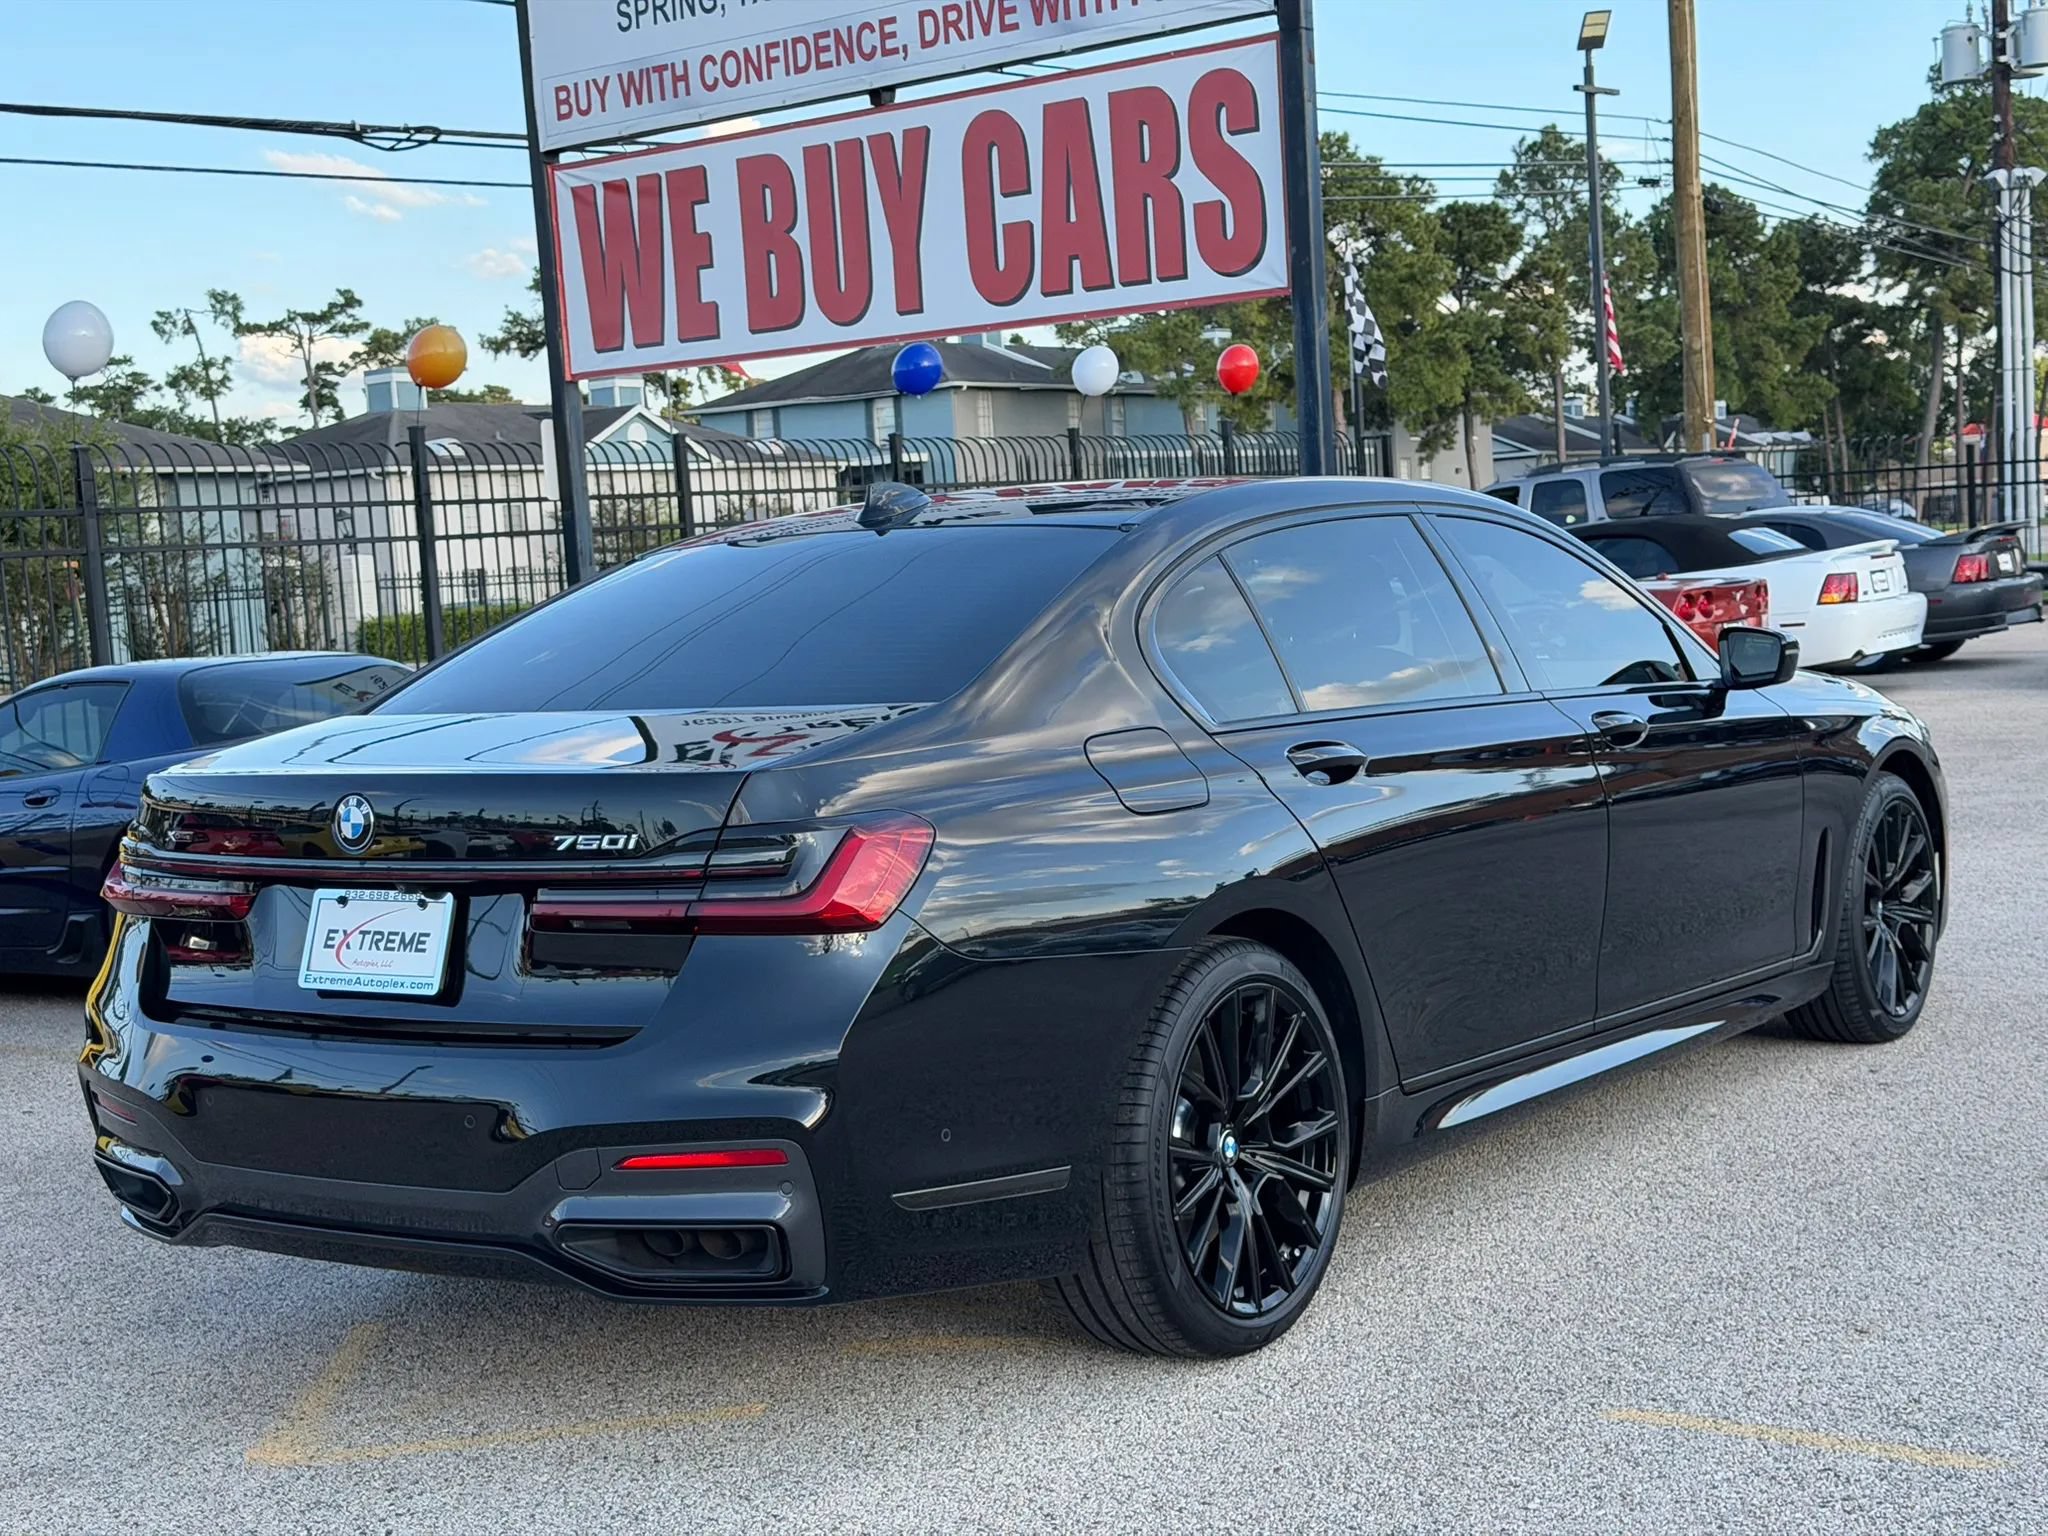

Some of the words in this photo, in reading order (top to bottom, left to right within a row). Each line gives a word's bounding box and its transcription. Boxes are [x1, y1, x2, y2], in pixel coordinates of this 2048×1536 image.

[553, 75, 611, 122] BUY
[617, 60, 692, 109] WITH
[699, 15, 909, 93] CONFIDENCE,
[918, 0, 1021, 50] DRIVE
[571, 164, 721, 353] WE
[735, 125, 932, 335] BUY
[961, 67, 1268, 307] CARS
[552, 833, 639, 851] 750i
[322, 928, 431, 954] EXTREME
[303, 973, 434, 991] ExtremeAutoplex.com
